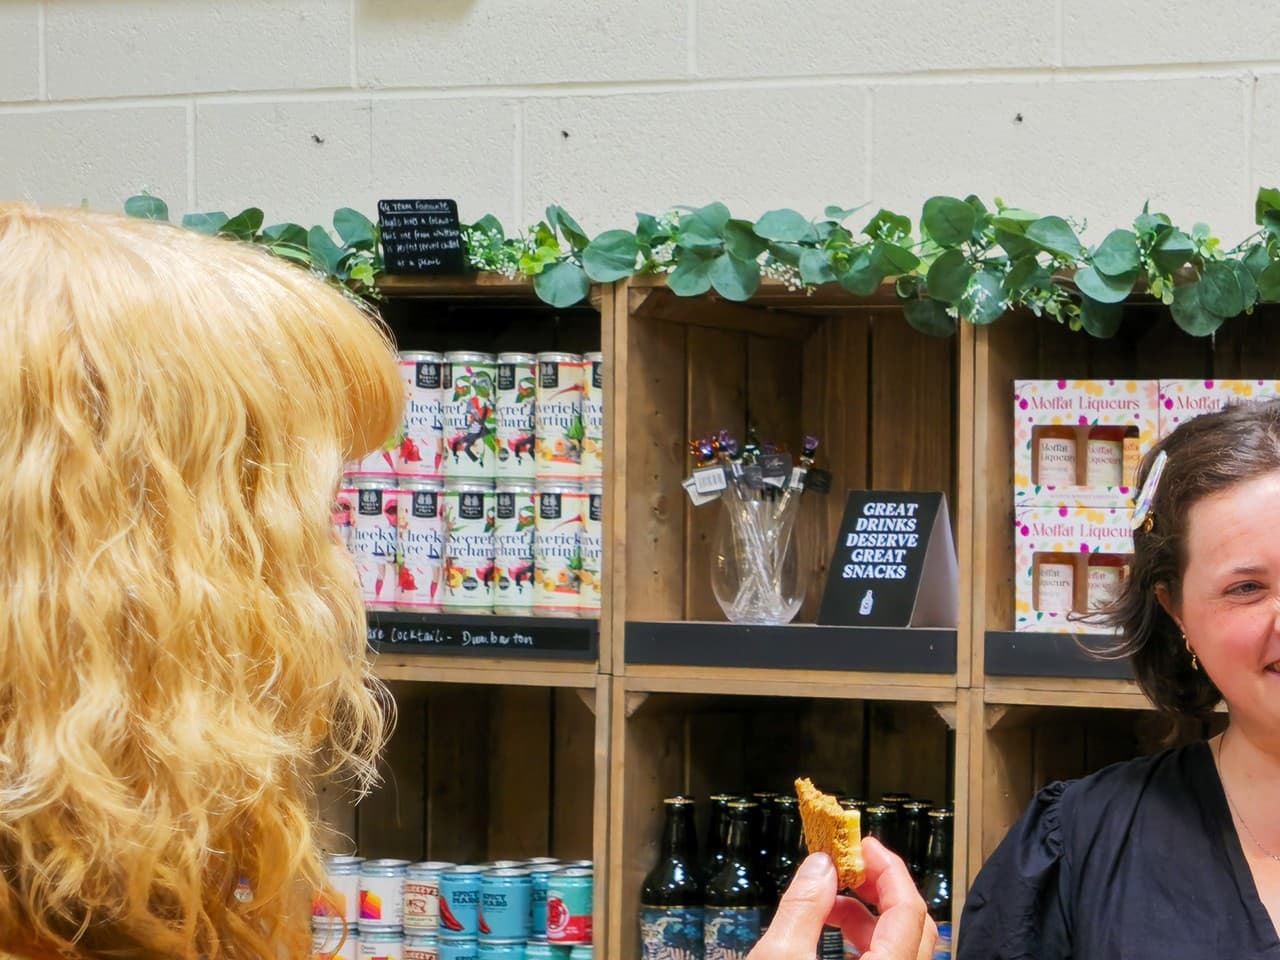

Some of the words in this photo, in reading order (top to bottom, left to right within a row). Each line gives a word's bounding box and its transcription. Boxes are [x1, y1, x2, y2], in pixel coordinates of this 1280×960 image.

[1031, 395, 1072, 410] Moffat
[1079, 395, 1140, 413] Liqueurs
[1177, 395, 1220, 410] Moffat
[863, 503, 918, 516] GREAT
[855, 518, 917, 531] DRINKS
[1032, 523, 1074, 537] Moffat
[1080, 523, 1134, 540] Liqueur
[846, 534, 918, 547] DESERVE
[851, 550, 906, 563] GREAT
[842, 565, 907, 579] SNACKS
